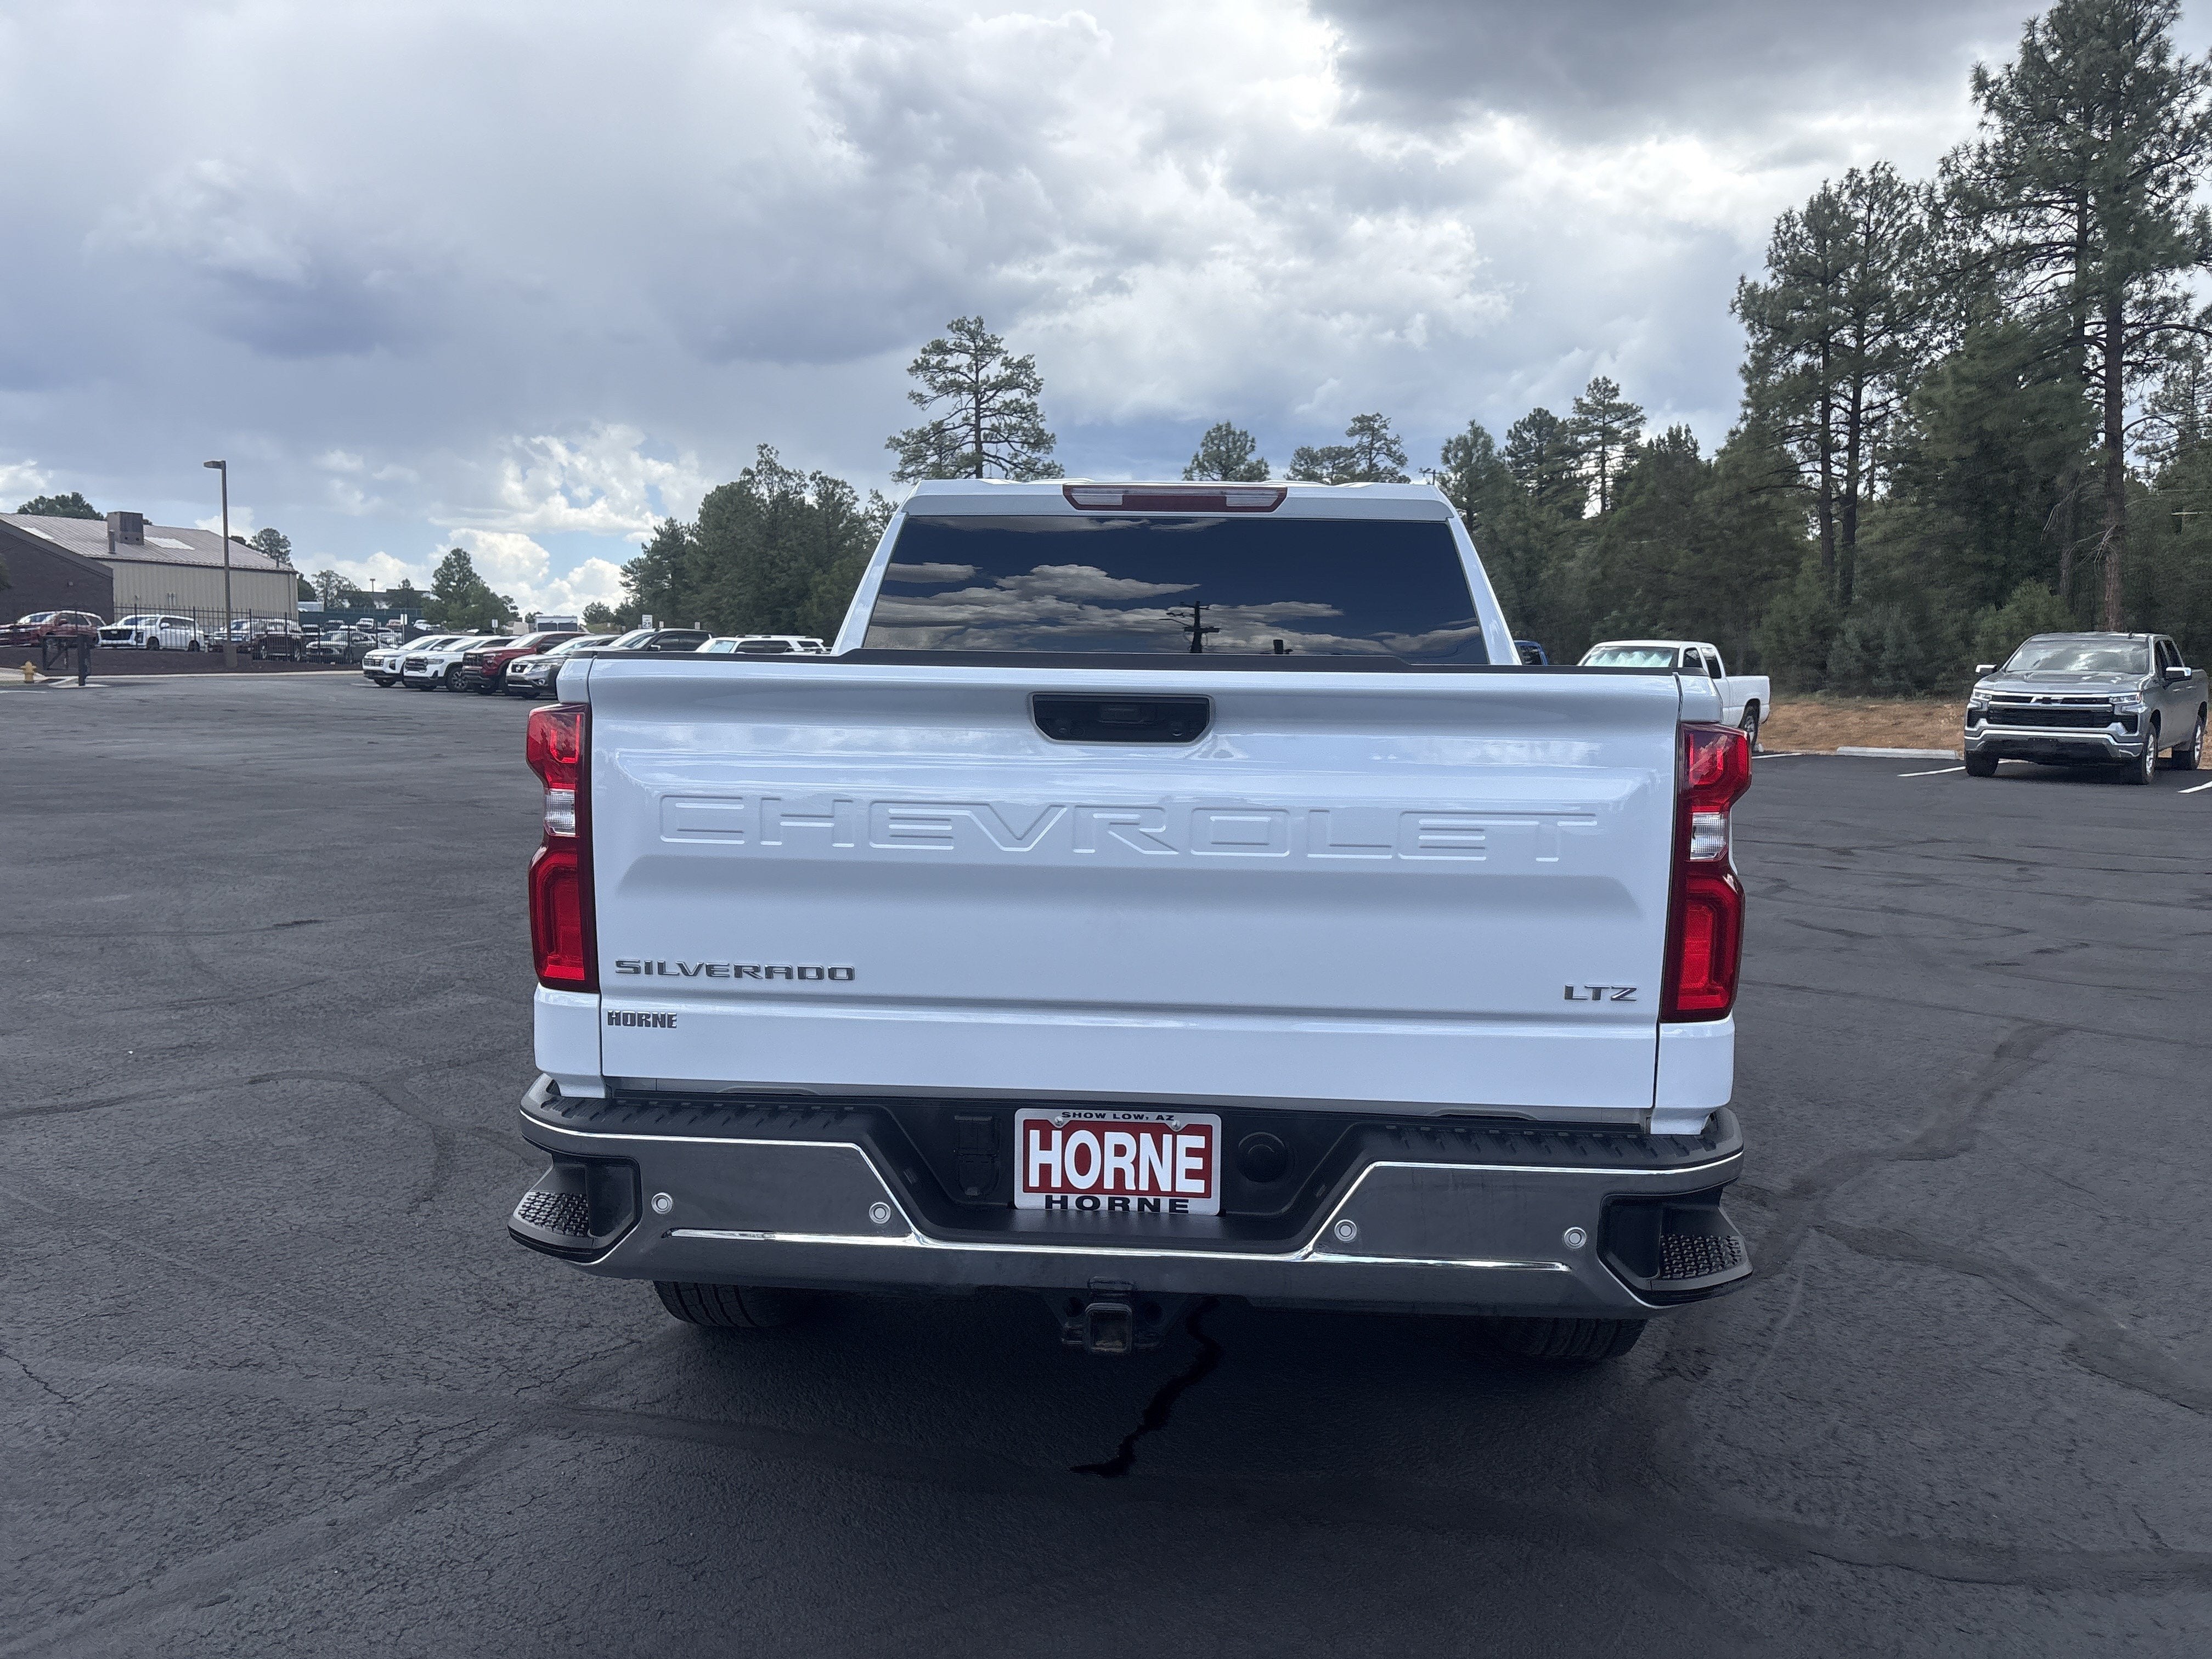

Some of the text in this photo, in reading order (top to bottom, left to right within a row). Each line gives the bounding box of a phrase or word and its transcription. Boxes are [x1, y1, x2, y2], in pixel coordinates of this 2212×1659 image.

[660, 795, 1598, 862] CHEVROLET
[615, 958, 855, 981] SILVERADO
[1564, 984, 1637, 1001] LTZ
[607, 1010, 678, 1029] HORNE
[1029, 1130, 1205, 1193] HORNE
[1045, 1194, 1189, 1214] HORNE
